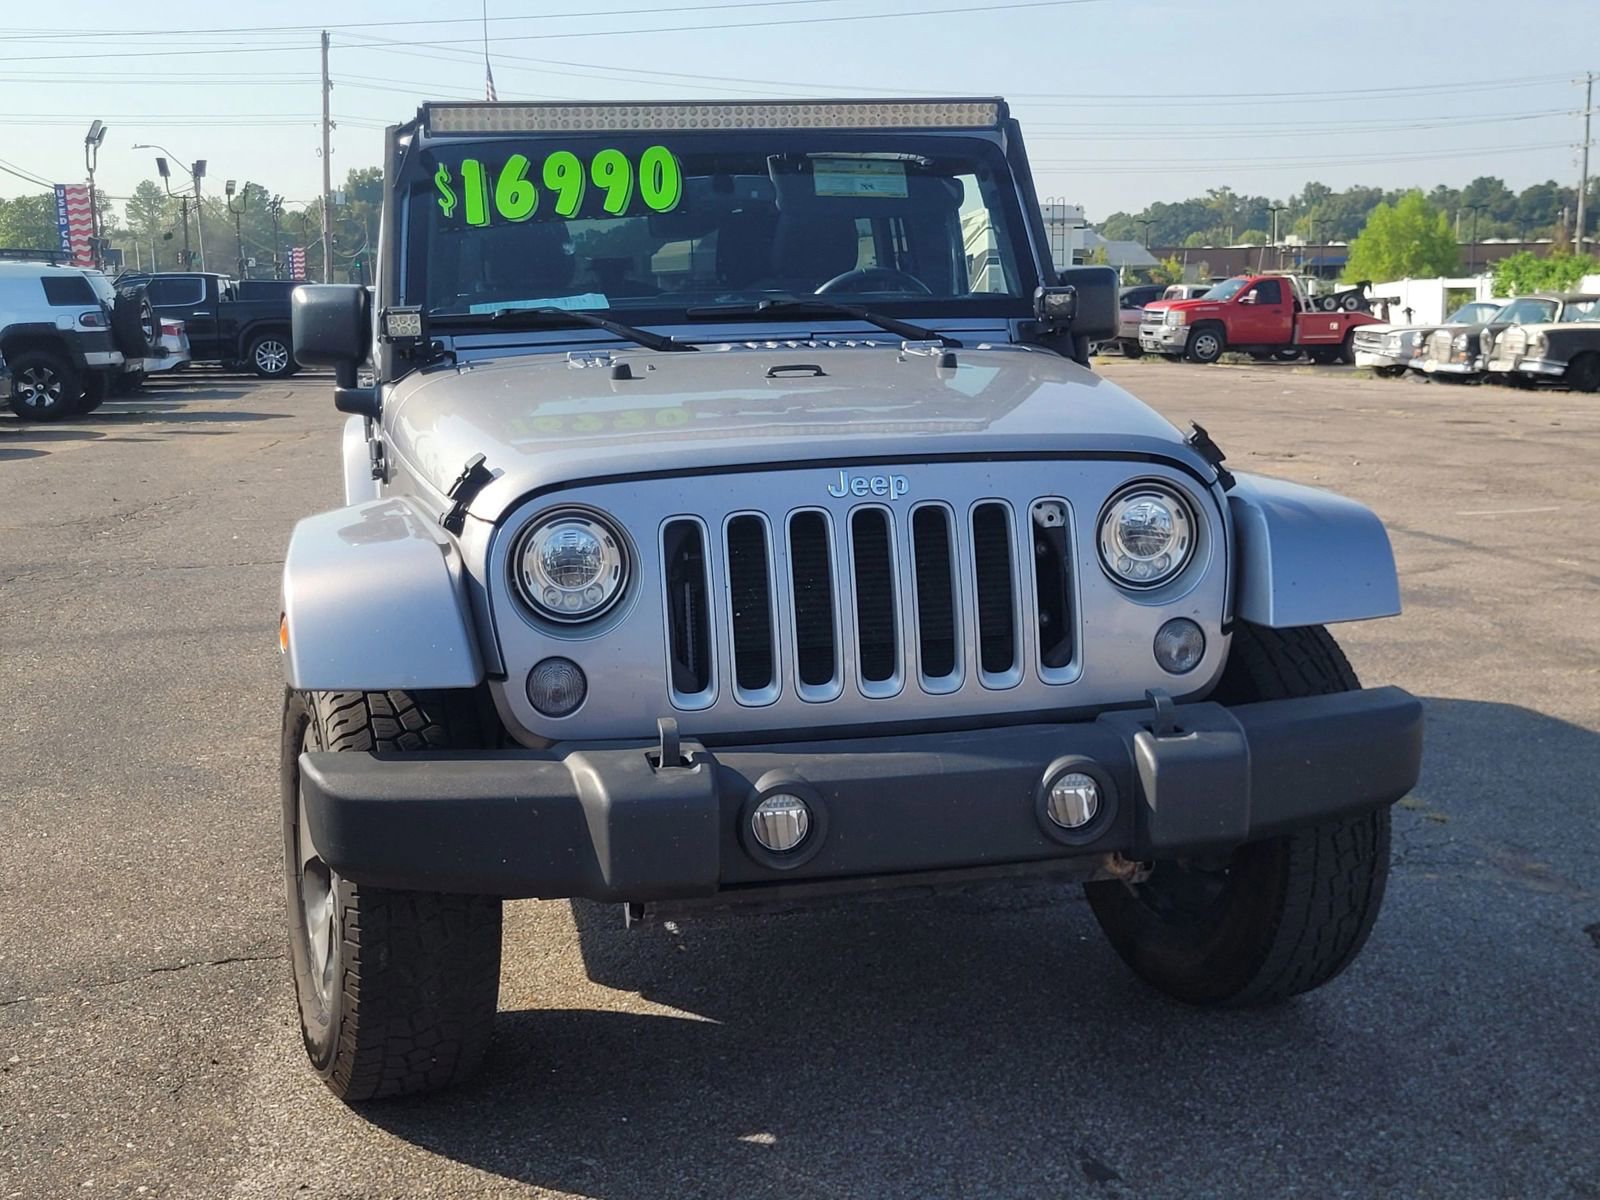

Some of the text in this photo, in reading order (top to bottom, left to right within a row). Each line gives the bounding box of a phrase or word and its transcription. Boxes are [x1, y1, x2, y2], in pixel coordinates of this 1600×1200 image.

[434, 145, 683, 227] $16990
[56, 189, 68, 225] USED
[827, 470, 910, 500] Jeep
